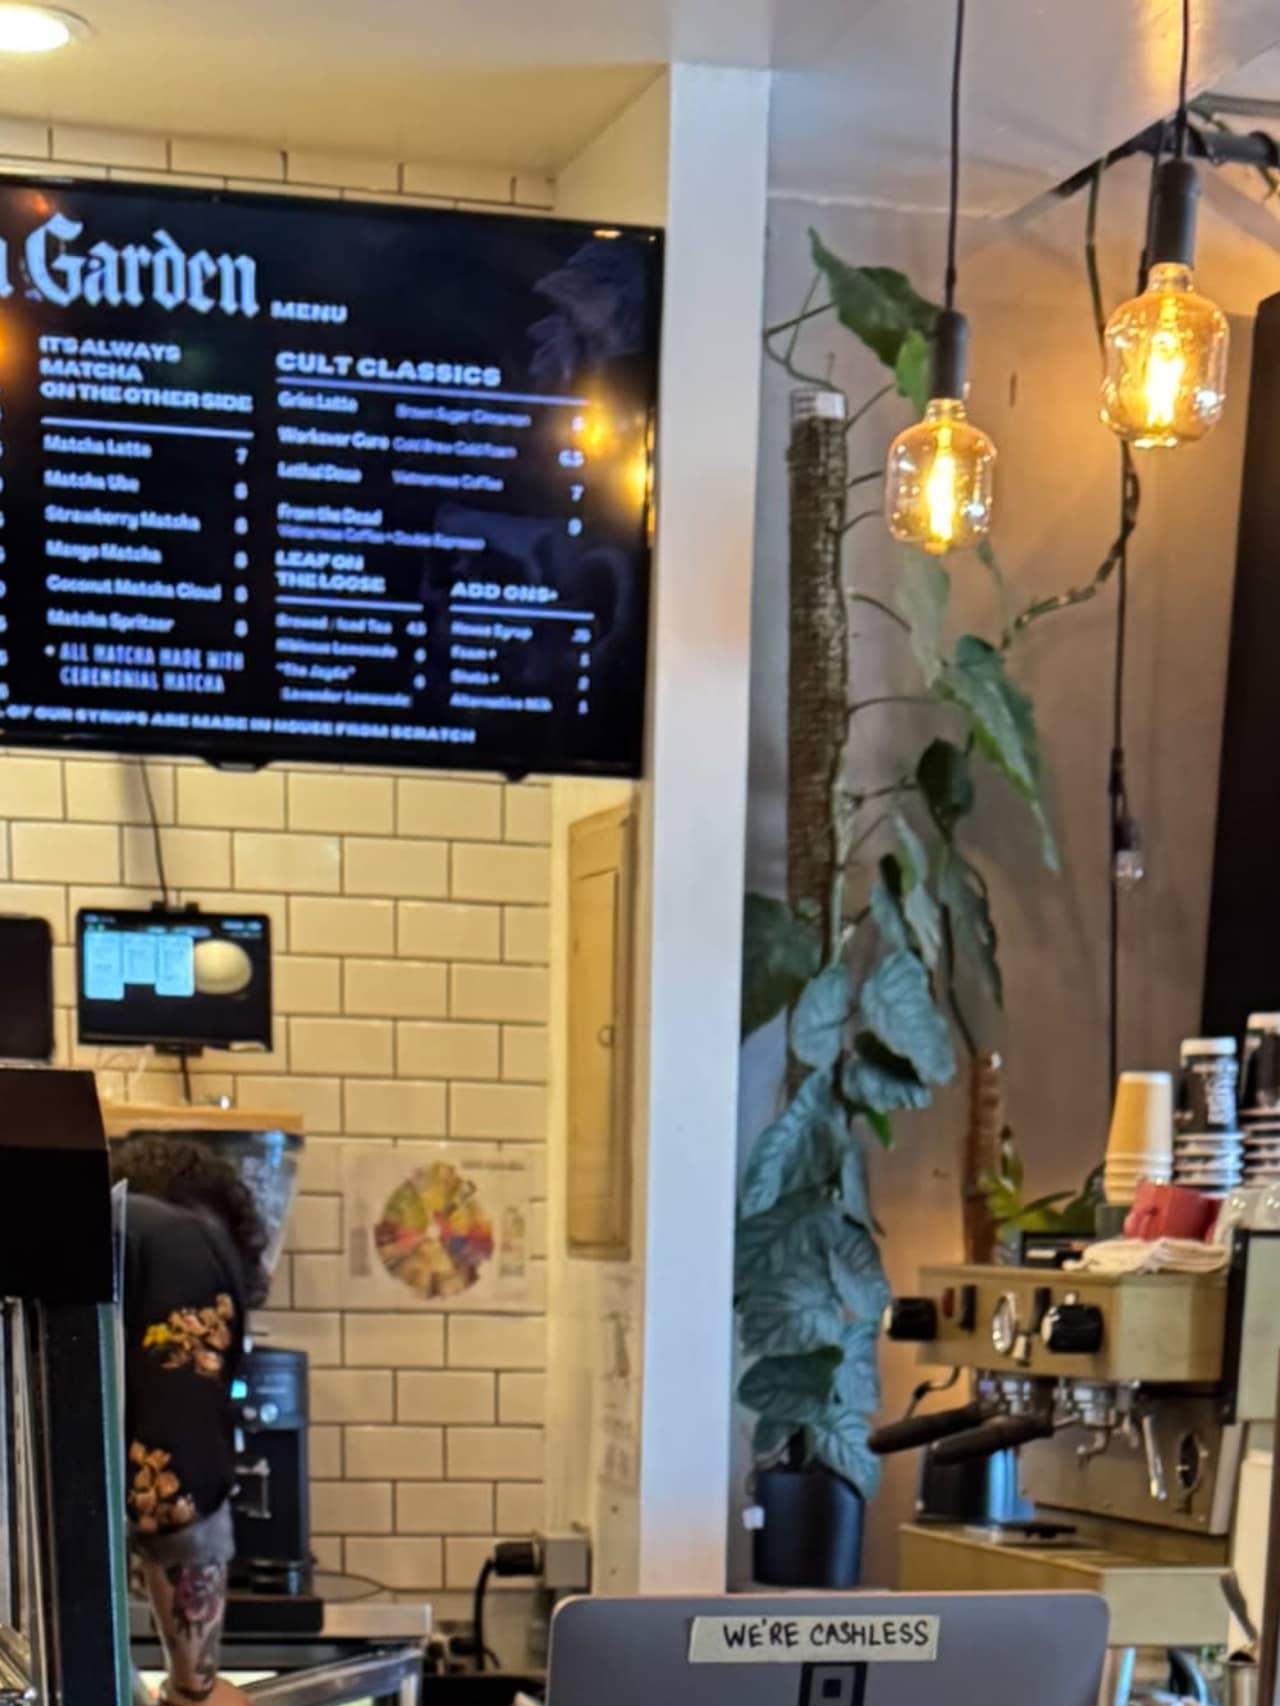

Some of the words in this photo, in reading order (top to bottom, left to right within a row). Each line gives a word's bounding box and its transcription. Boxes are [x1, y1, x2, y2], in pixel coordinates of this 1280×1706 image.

[25, 212, 260, 317] Garden
[271, 301, 347, 323] MENU
[79, 338, 181, 363] ALWAYS
[39, 358, 143, 382] MATCHA
[276, 351, 353, 375] CULT
[356, 357, 501, 387] CLASSICS
[40, 381, 75, 399] ON
[77, 383, 122, 402] THE
[123, 387, 199, 409] OTHER
[200, 393, 253, 413] SIDE
[43, 434, 105, 455] Matcha
[107, 438, 152, 459] Latte
[44, 469, 105, 490] Matcha
[44, 504, 139, 531] Strawberry
[140, 511, 201, 532] Matcha
[101, 543, 163, 564] Matcha
[275, 550, 329, 568] LEAF
[331, 554, 364, 571] ON
[114, 578, 175, 598] Matcha
[274, 570, 317, 588] THE
[318, 572, 386, 593] LOOSE
[450, 582, 501, 600] ADD
[47, 608, 108, 628] Matcha
[75, 707, 149, 725] SYRUPS
[150, 710, 189, 727] ARE
[191, 713, 248, 730] MADE
[272, 719, 333, 735] HOUSE
[335, 721, 389, 739] FROM
[391, 724, 476, 744] SCRATCH
[722, 1617, 799, 1648] WE'RE
[810, 1618, 930, 1647] CASHLESS
